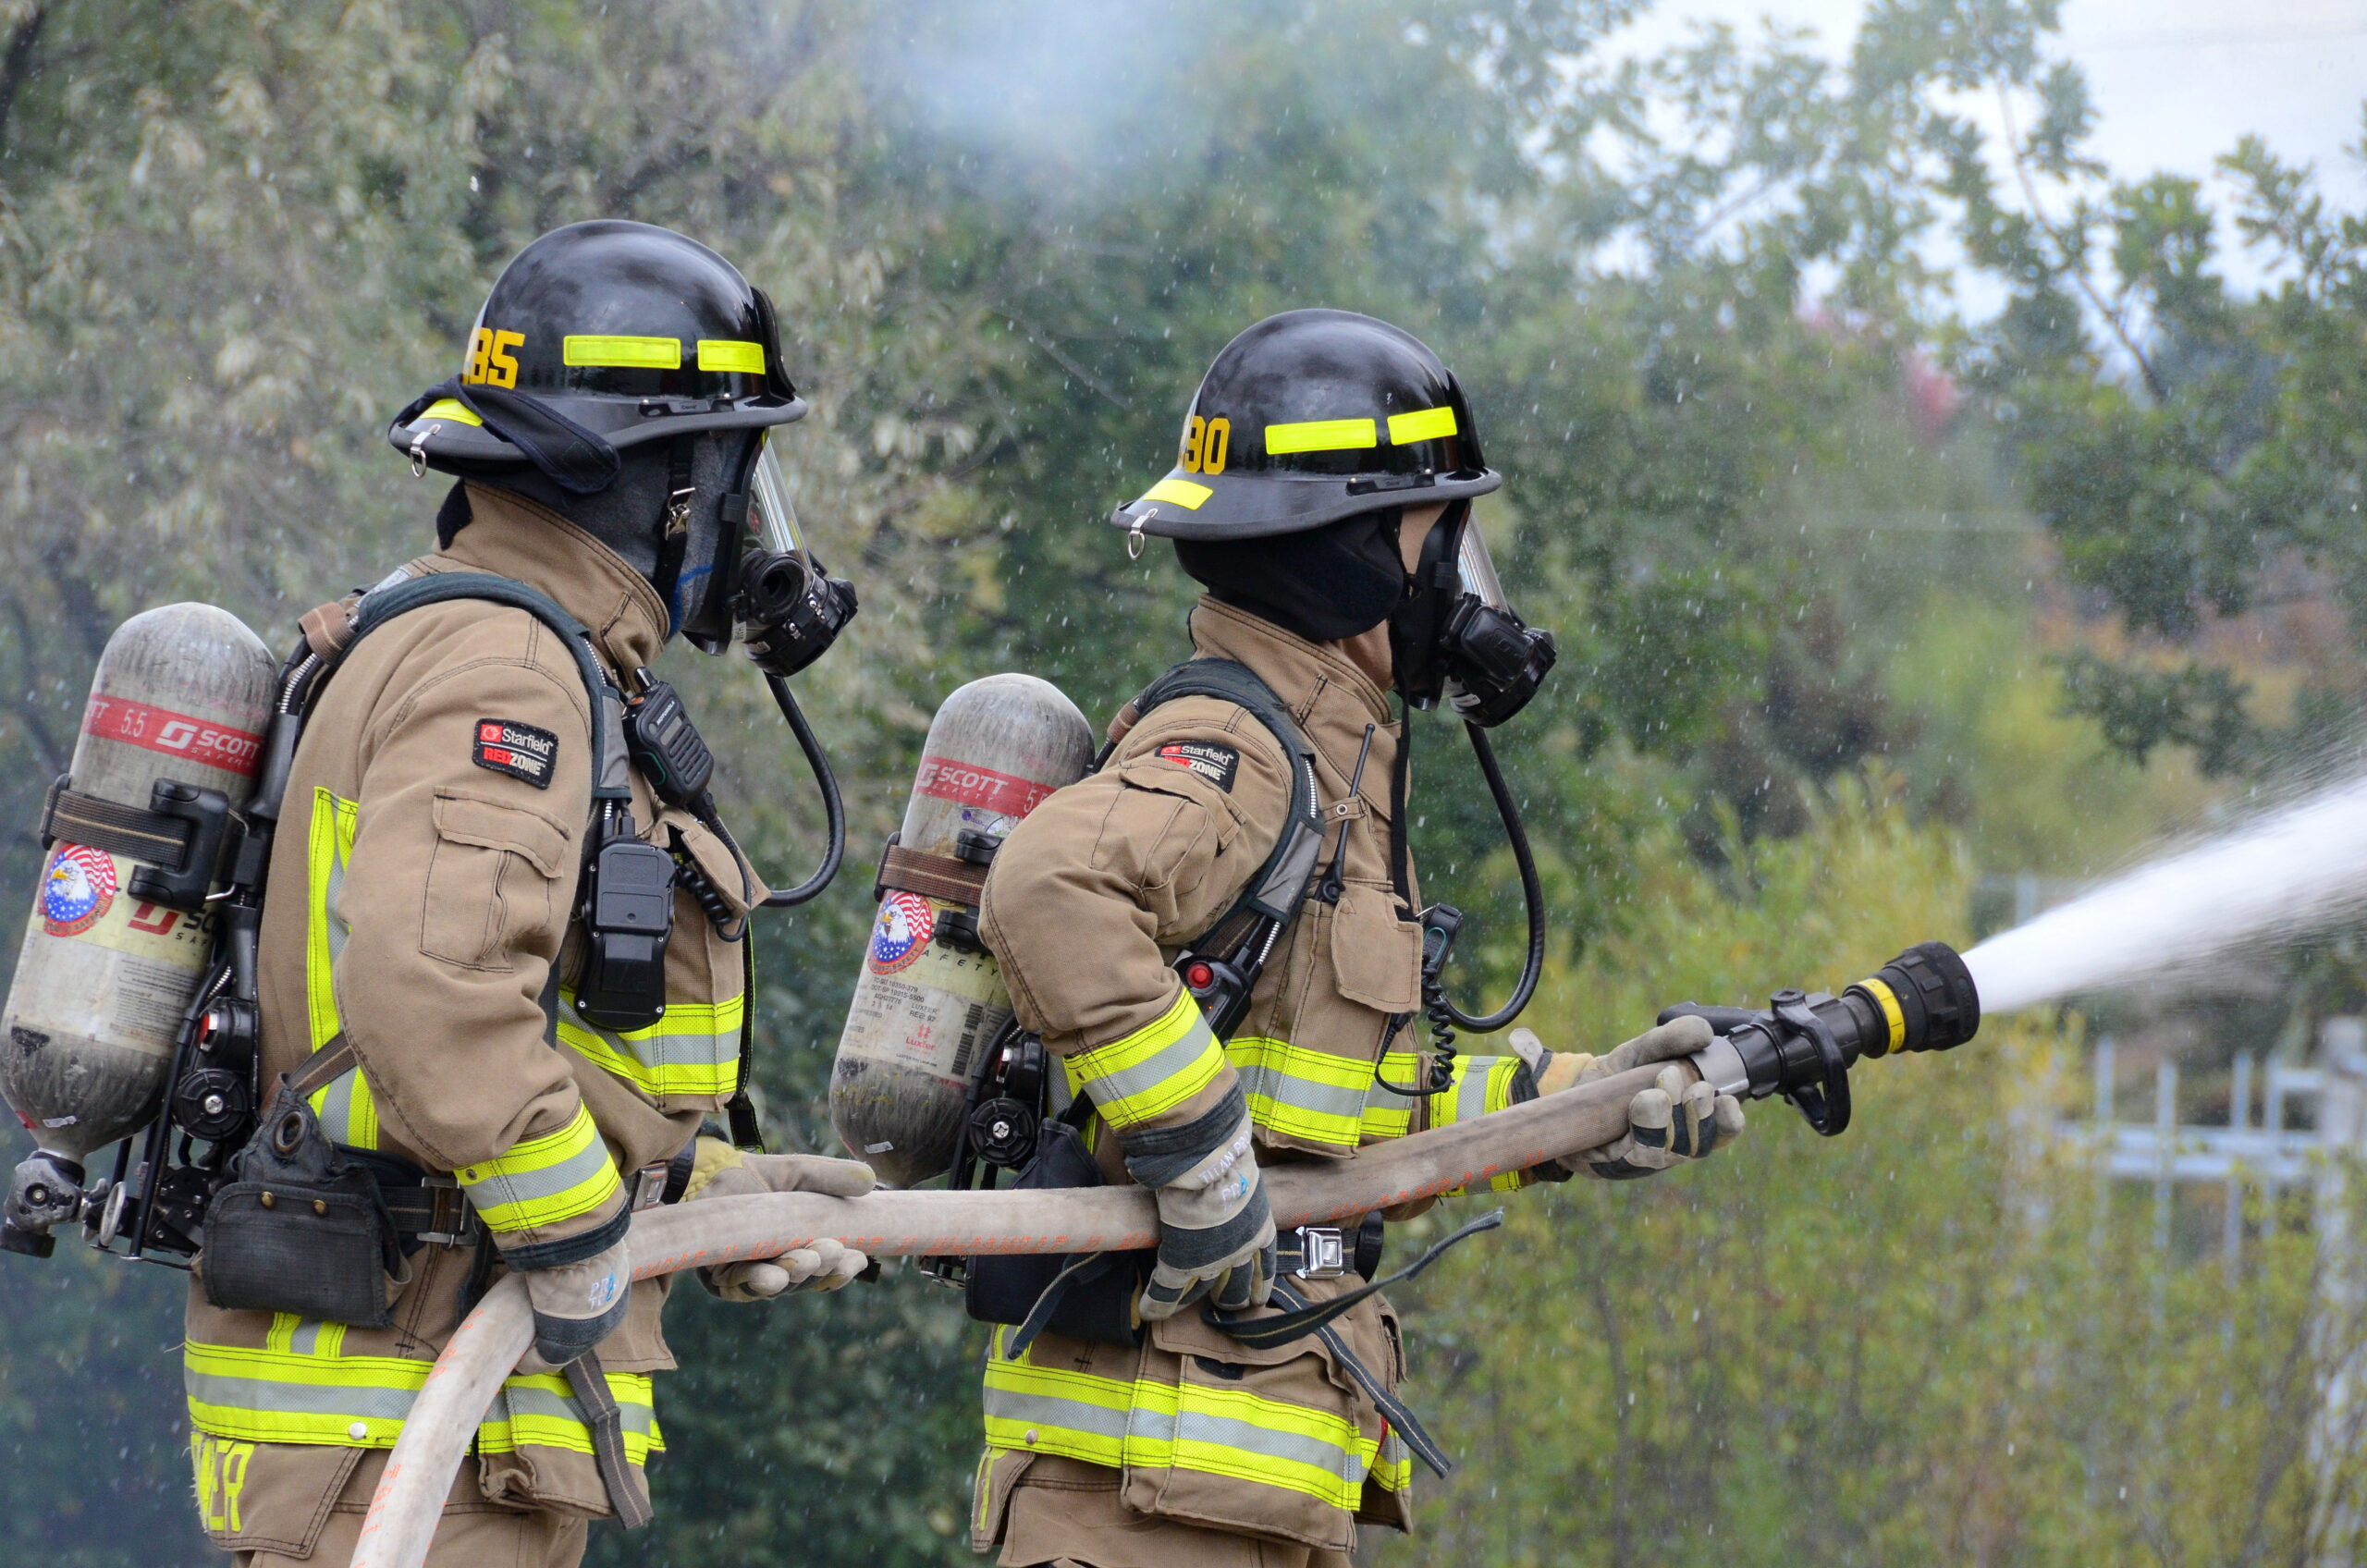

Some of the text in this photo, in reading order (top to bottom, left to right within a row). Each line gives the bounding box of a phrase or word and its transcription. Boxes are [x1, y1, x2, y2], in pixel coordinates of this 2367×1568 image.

[121, 708, 148, 738] 5.5
[197, 729, 260, 760] SCOTT
[501, 727, 549, 755] Starfield
[1180, 744, 1228, 766] Starfield
[938, 766, 1010, 795] SCOTT
[922, 948, 999, 976] AFETY
[1198, 1150, 1235, 1184] TITAN
